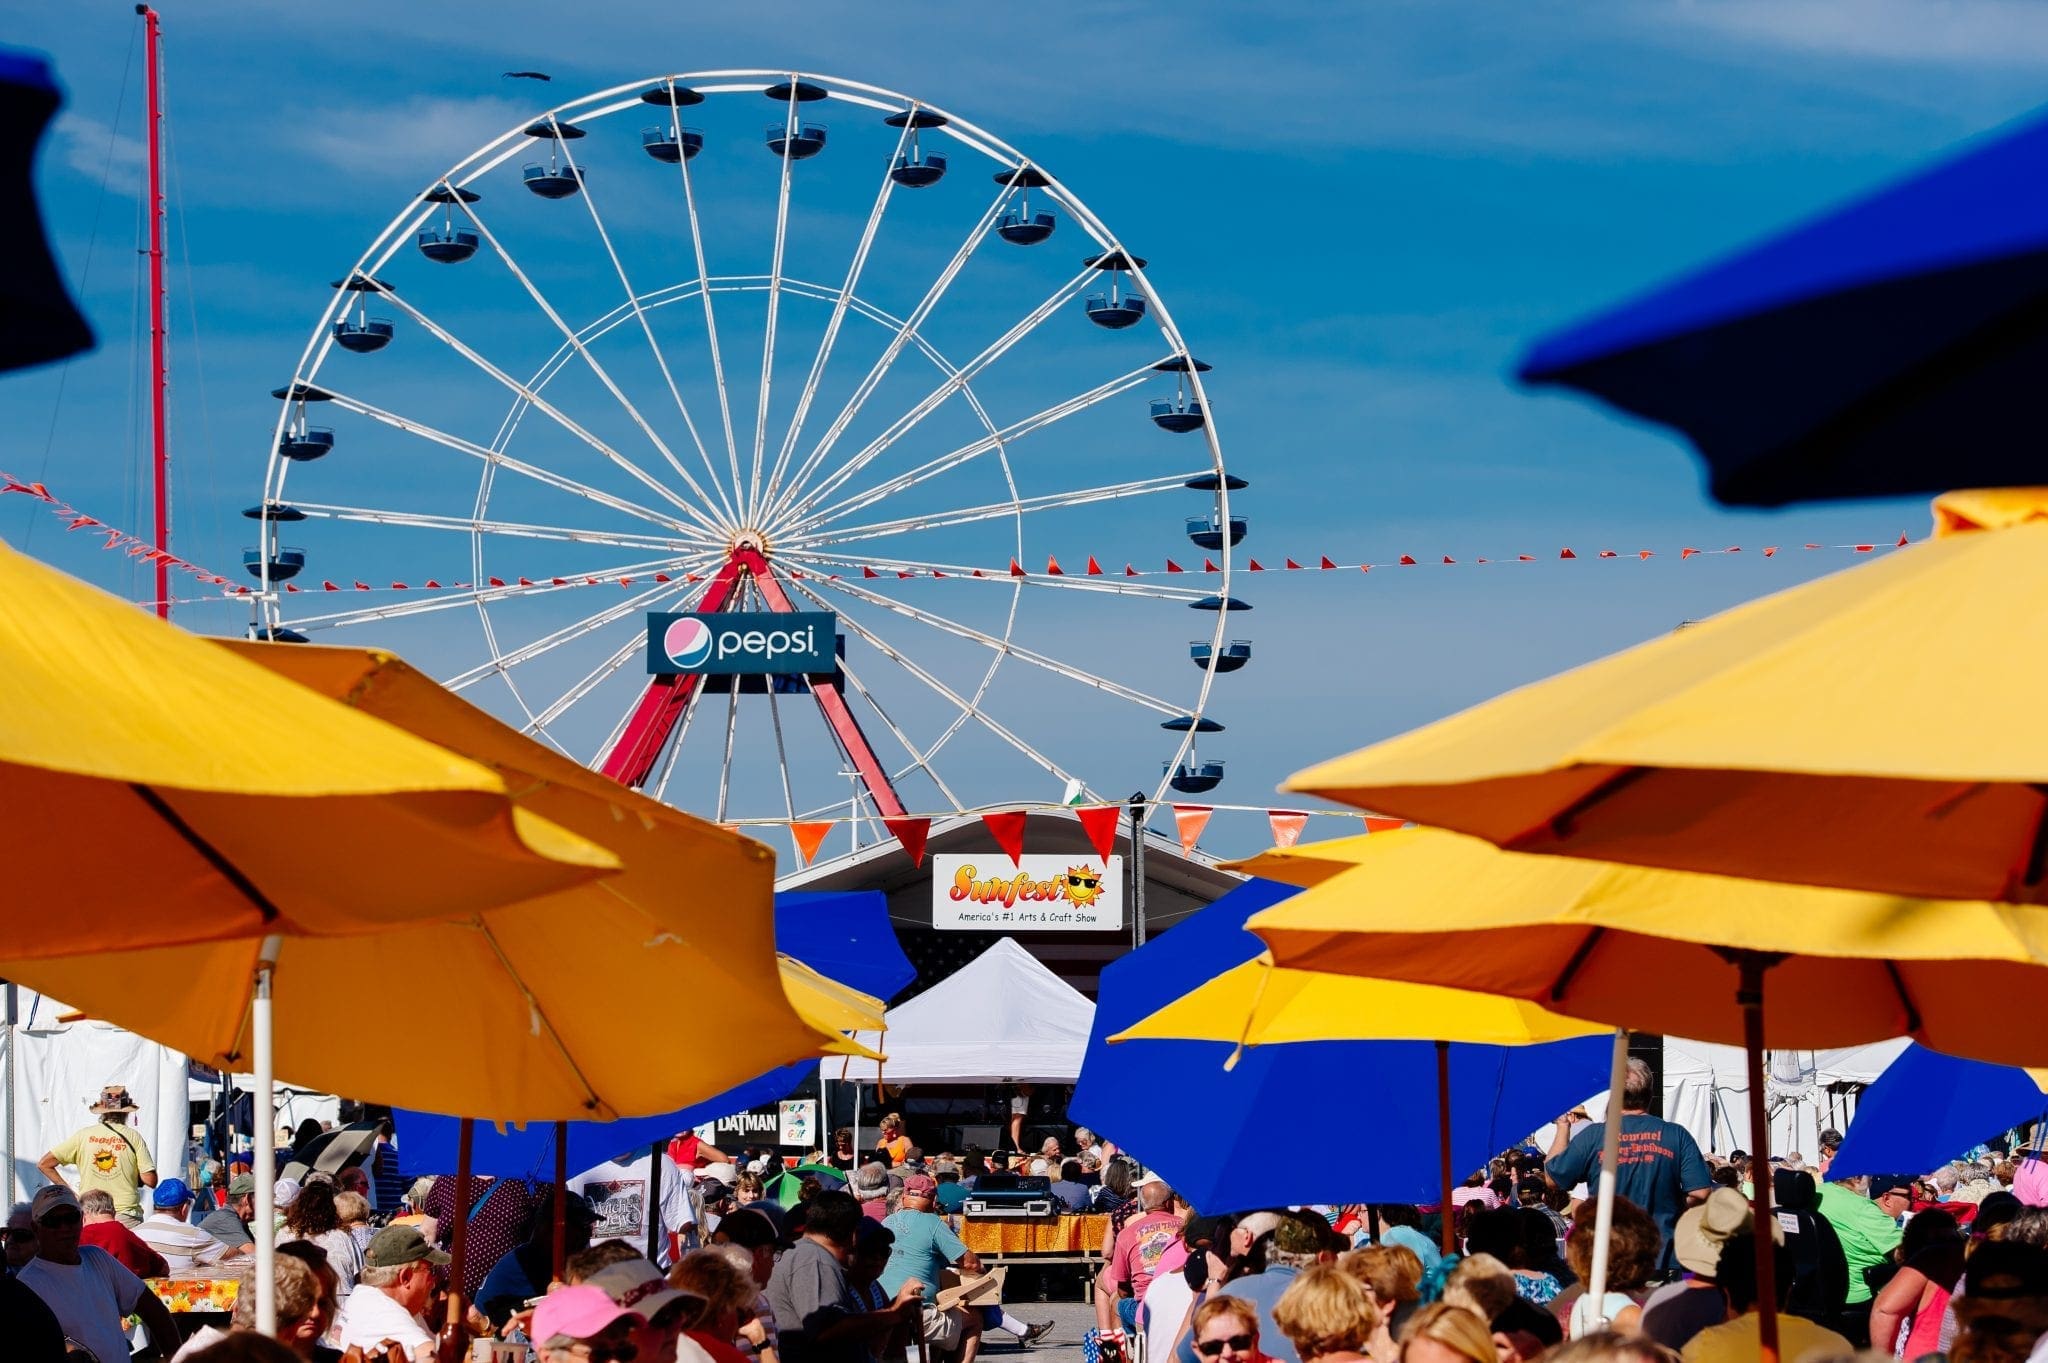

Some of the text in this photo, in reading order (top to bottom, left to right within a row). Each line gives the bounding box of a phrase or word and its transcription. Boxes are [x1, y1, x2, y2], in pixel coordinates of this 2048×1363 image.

[718, 625, 815, 660] pepsi
[949, 863, 1063, 909] Sunfest
[958, 912, 1097, 922] America's #1 Arts & Craft Show
